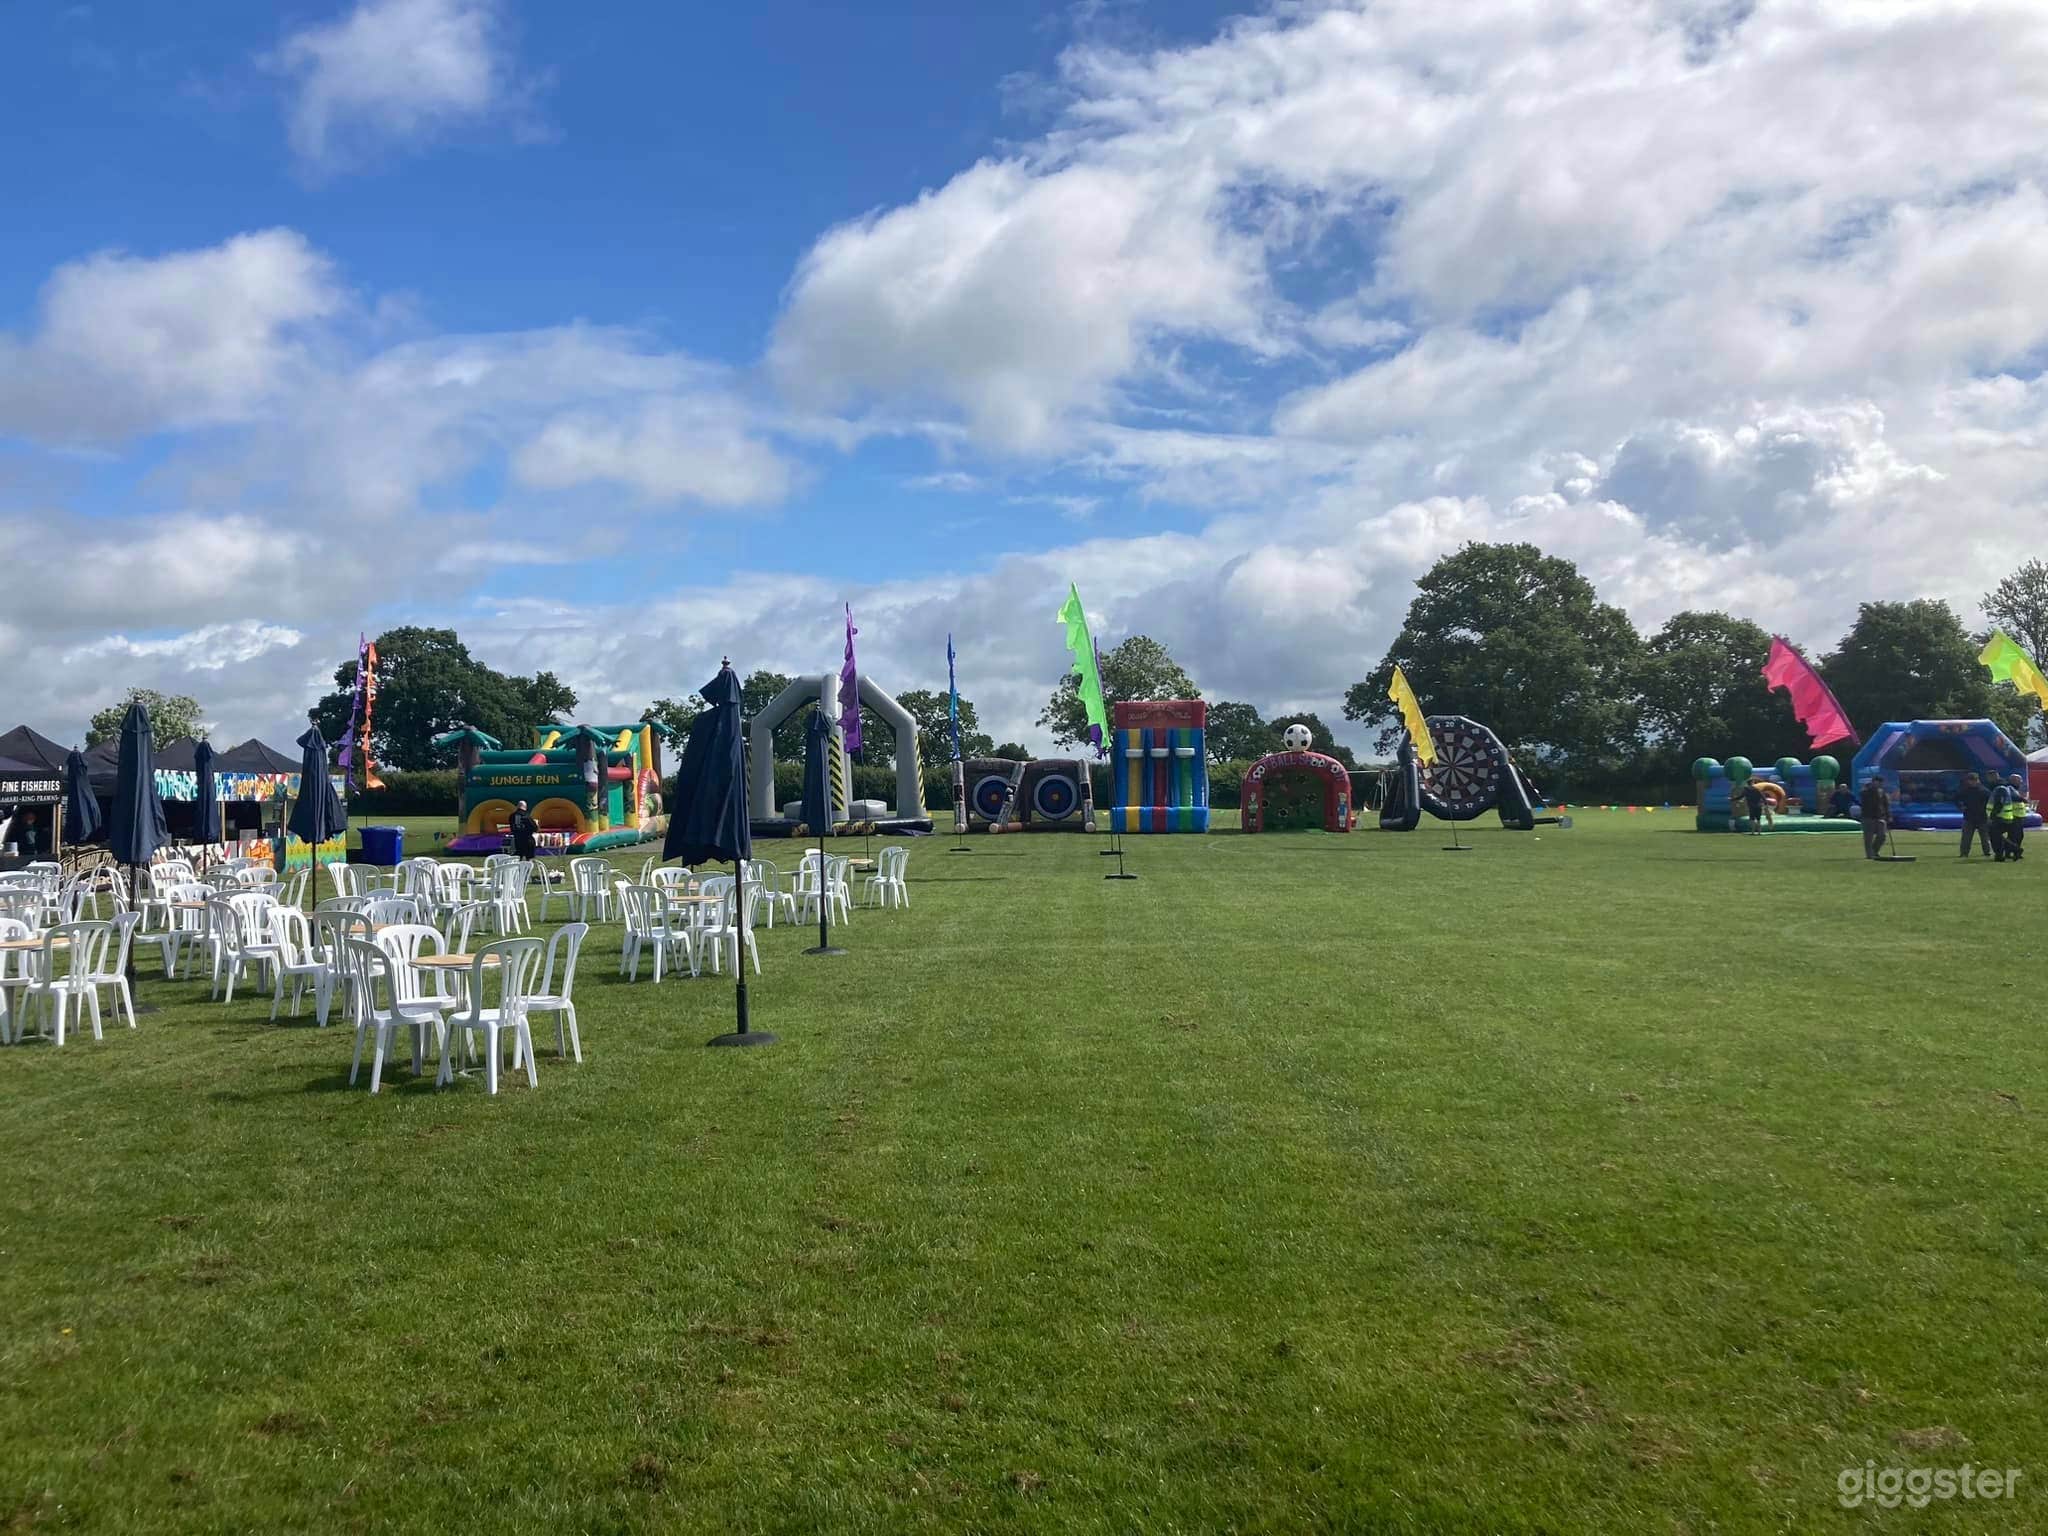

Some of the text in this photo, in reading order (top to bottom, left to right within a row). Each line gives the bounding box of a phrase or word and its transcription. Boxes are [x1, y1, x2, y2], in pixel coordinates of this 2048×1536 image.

[2, 780, 60, 792] FINE FISHERIES
[490, 775, 560, 786] JUNGLE RUN
